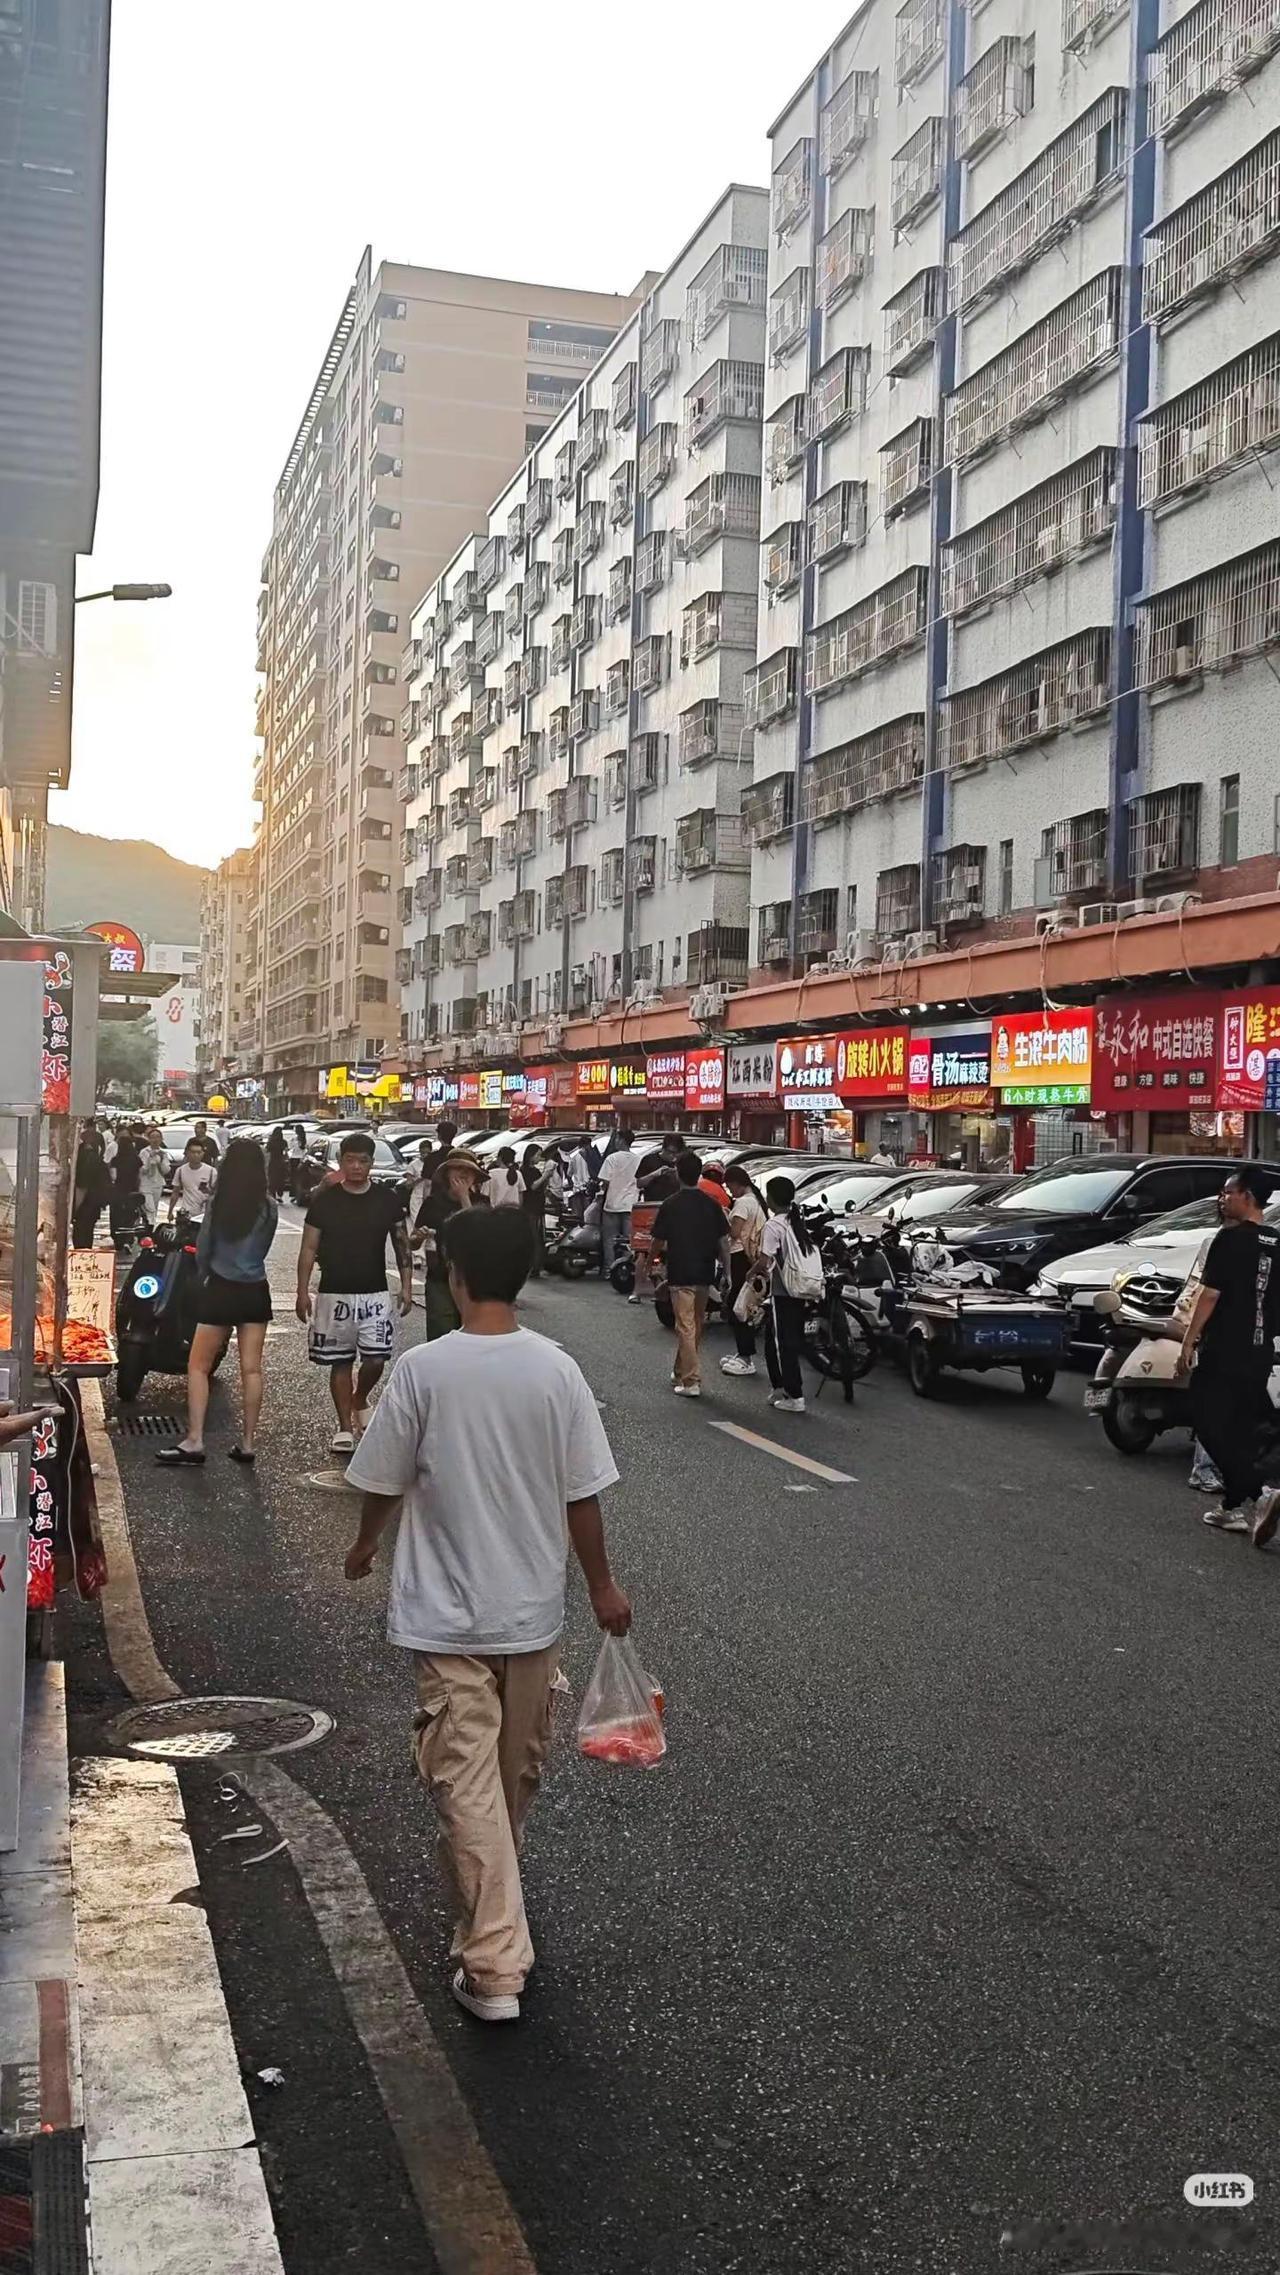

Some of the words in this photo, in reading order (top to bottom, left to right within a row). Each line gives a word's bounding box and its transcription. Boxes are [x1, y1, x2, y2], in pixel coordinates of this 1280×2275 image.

[51, 1016, 69, 1048] 潜江
[1015, 1026, 1087, 1067] 生滚牛肉粉
[1152, 1016, 1214, 1060] 中式自选快餐
[732, 1053, 773, 1085] 江西米粉
[847, 1037, 904, 1078] 旋转小火锅
[334, 1300, 384, 1321] Duke
[35, 1491, 53, 1533] 潜江
